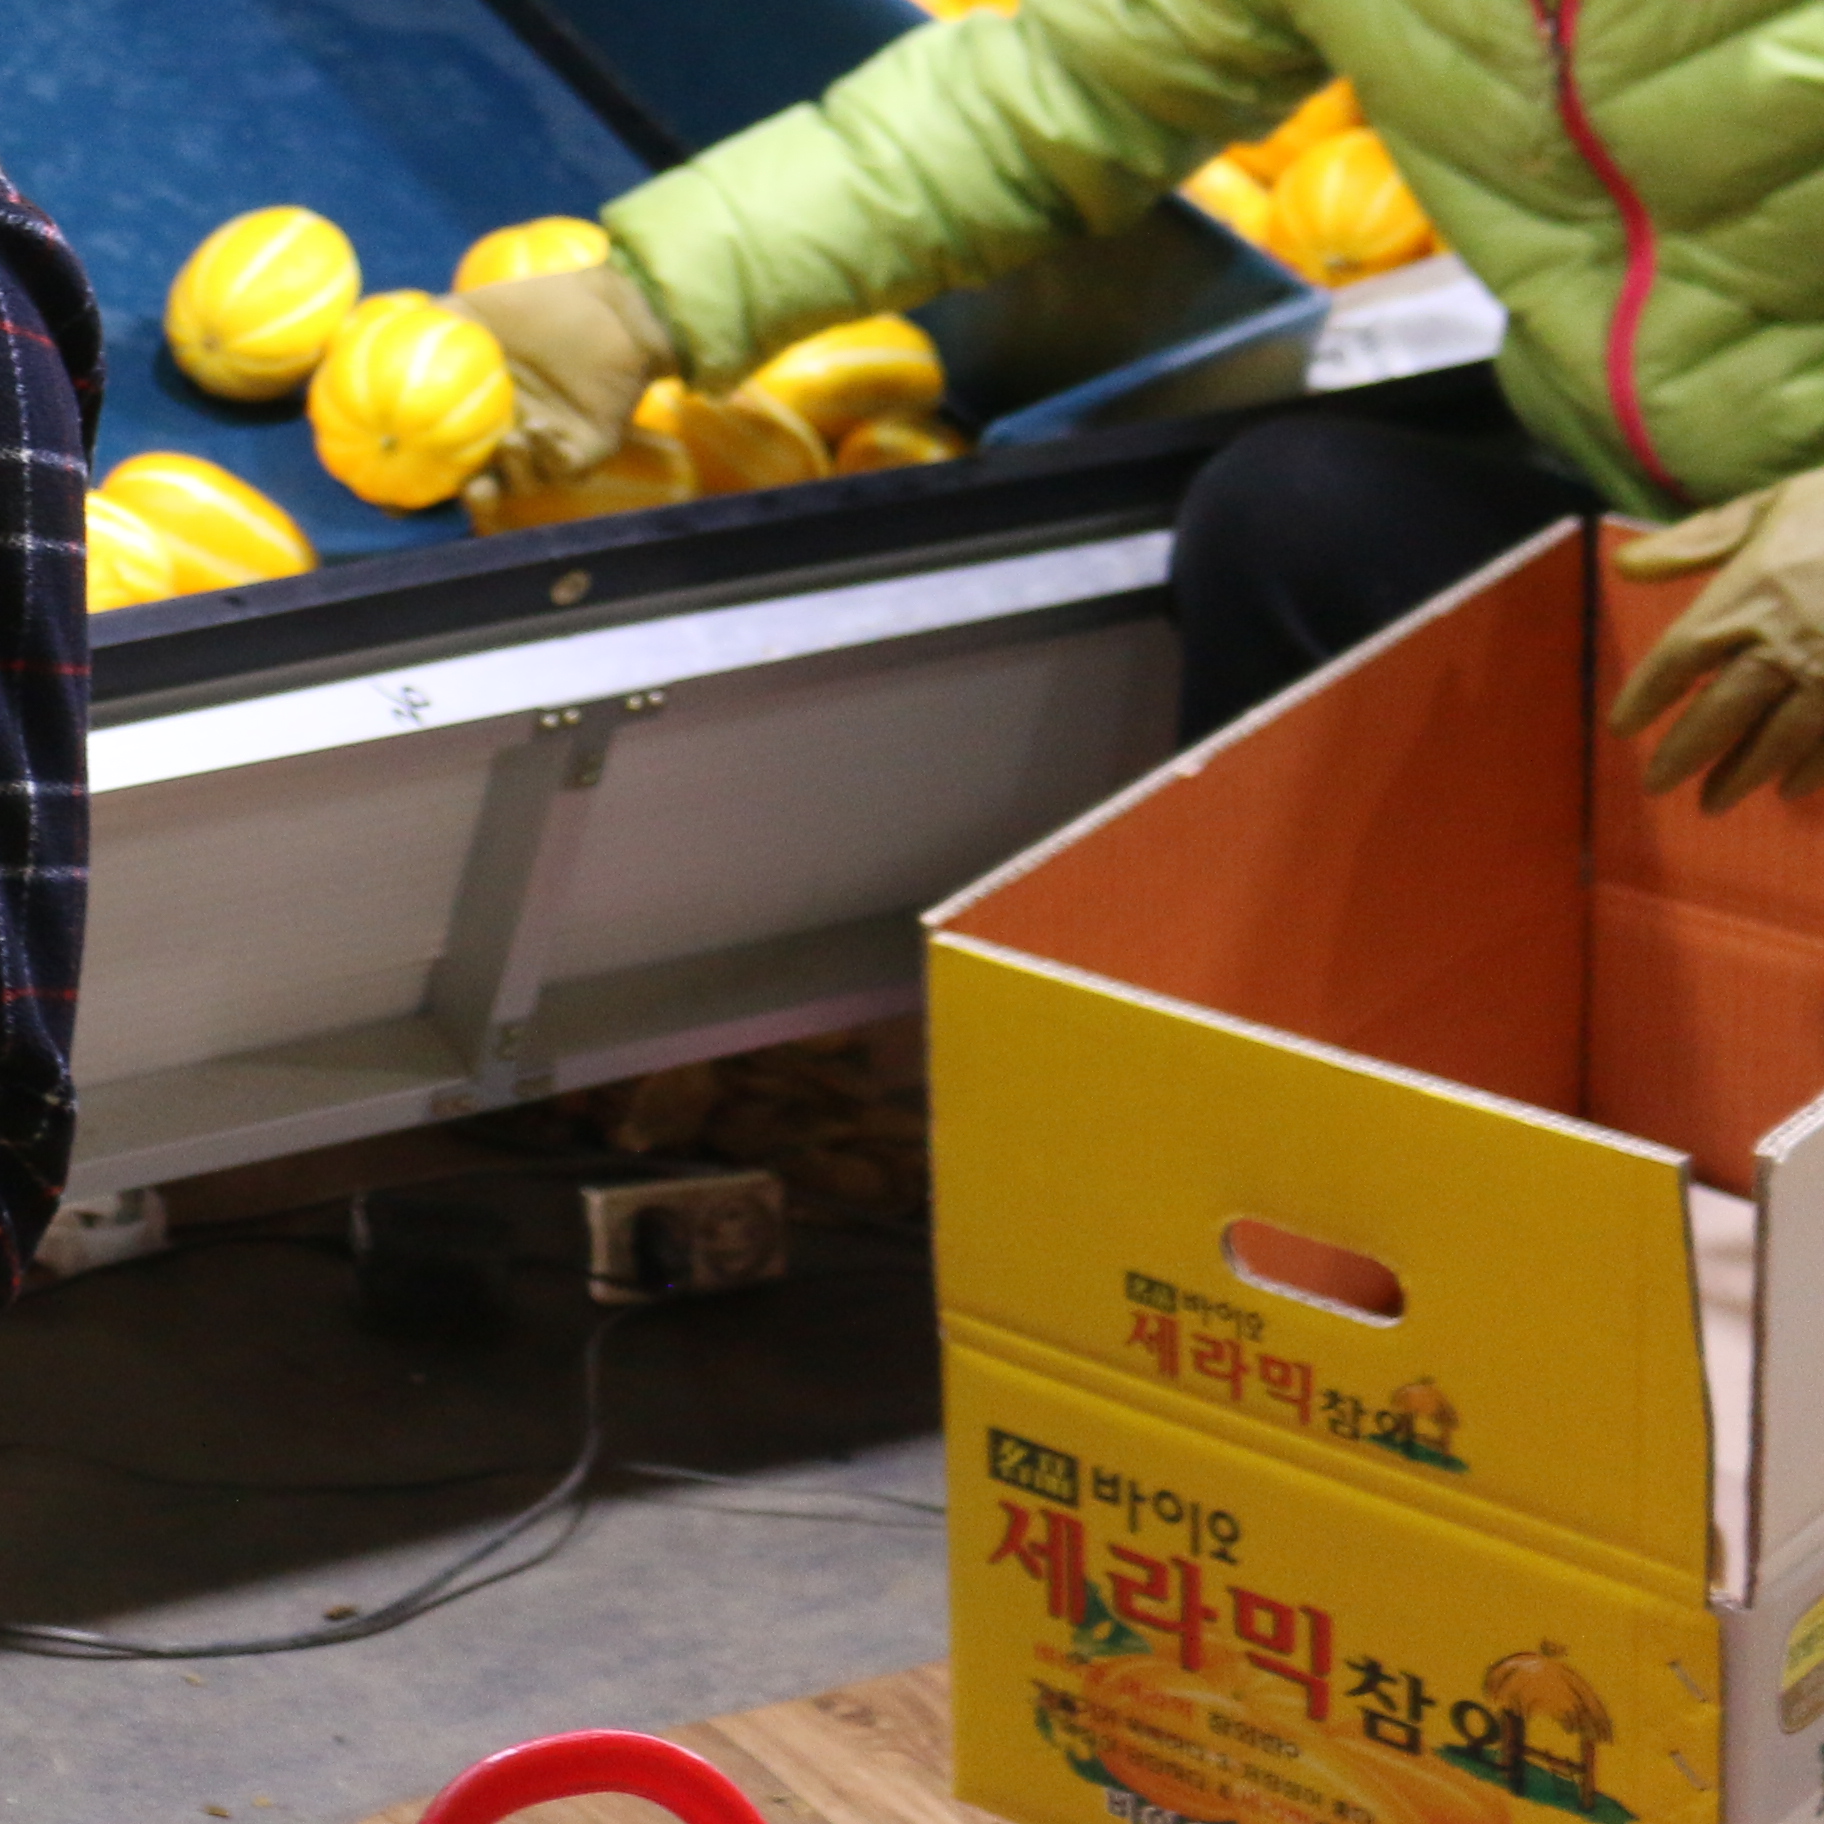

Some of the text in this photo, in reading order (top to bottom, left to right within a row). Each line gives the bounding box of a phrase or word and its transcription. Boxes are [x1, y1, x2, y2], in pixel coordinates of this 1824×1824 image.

[1124, 1310, 1414, 1453] 세라믹 참외
[1093, 1466, 1242, 1565] 바이오
[988, 1498, 1334, 1722] 세라믹
[1344, 1654, 1525, 1796] 참외
